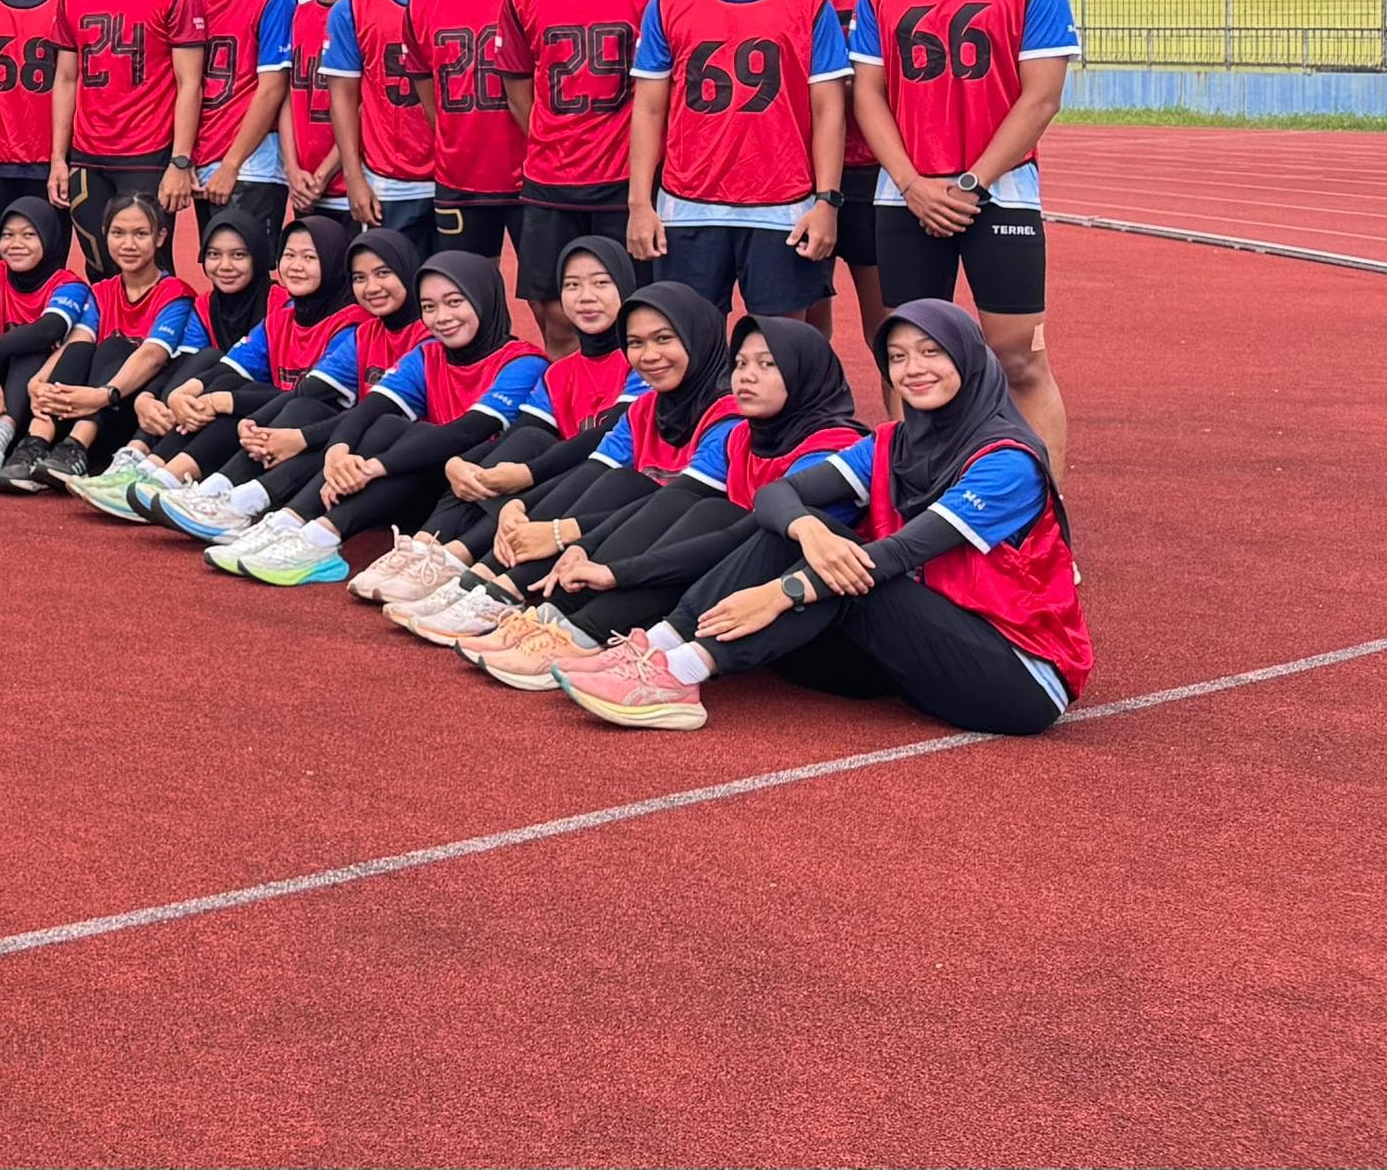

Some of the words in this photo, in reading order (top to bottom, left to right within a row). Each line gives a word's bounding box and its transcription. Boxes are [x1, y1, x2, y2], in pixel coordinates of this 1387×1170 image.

[79, 13, 146, 89] 24
[542, 21, 634, 117] 29
[684, 37, 782, 114] 69
[894, 2, 994, 82] 66
[991, 224, 1037, 236] TERREL
